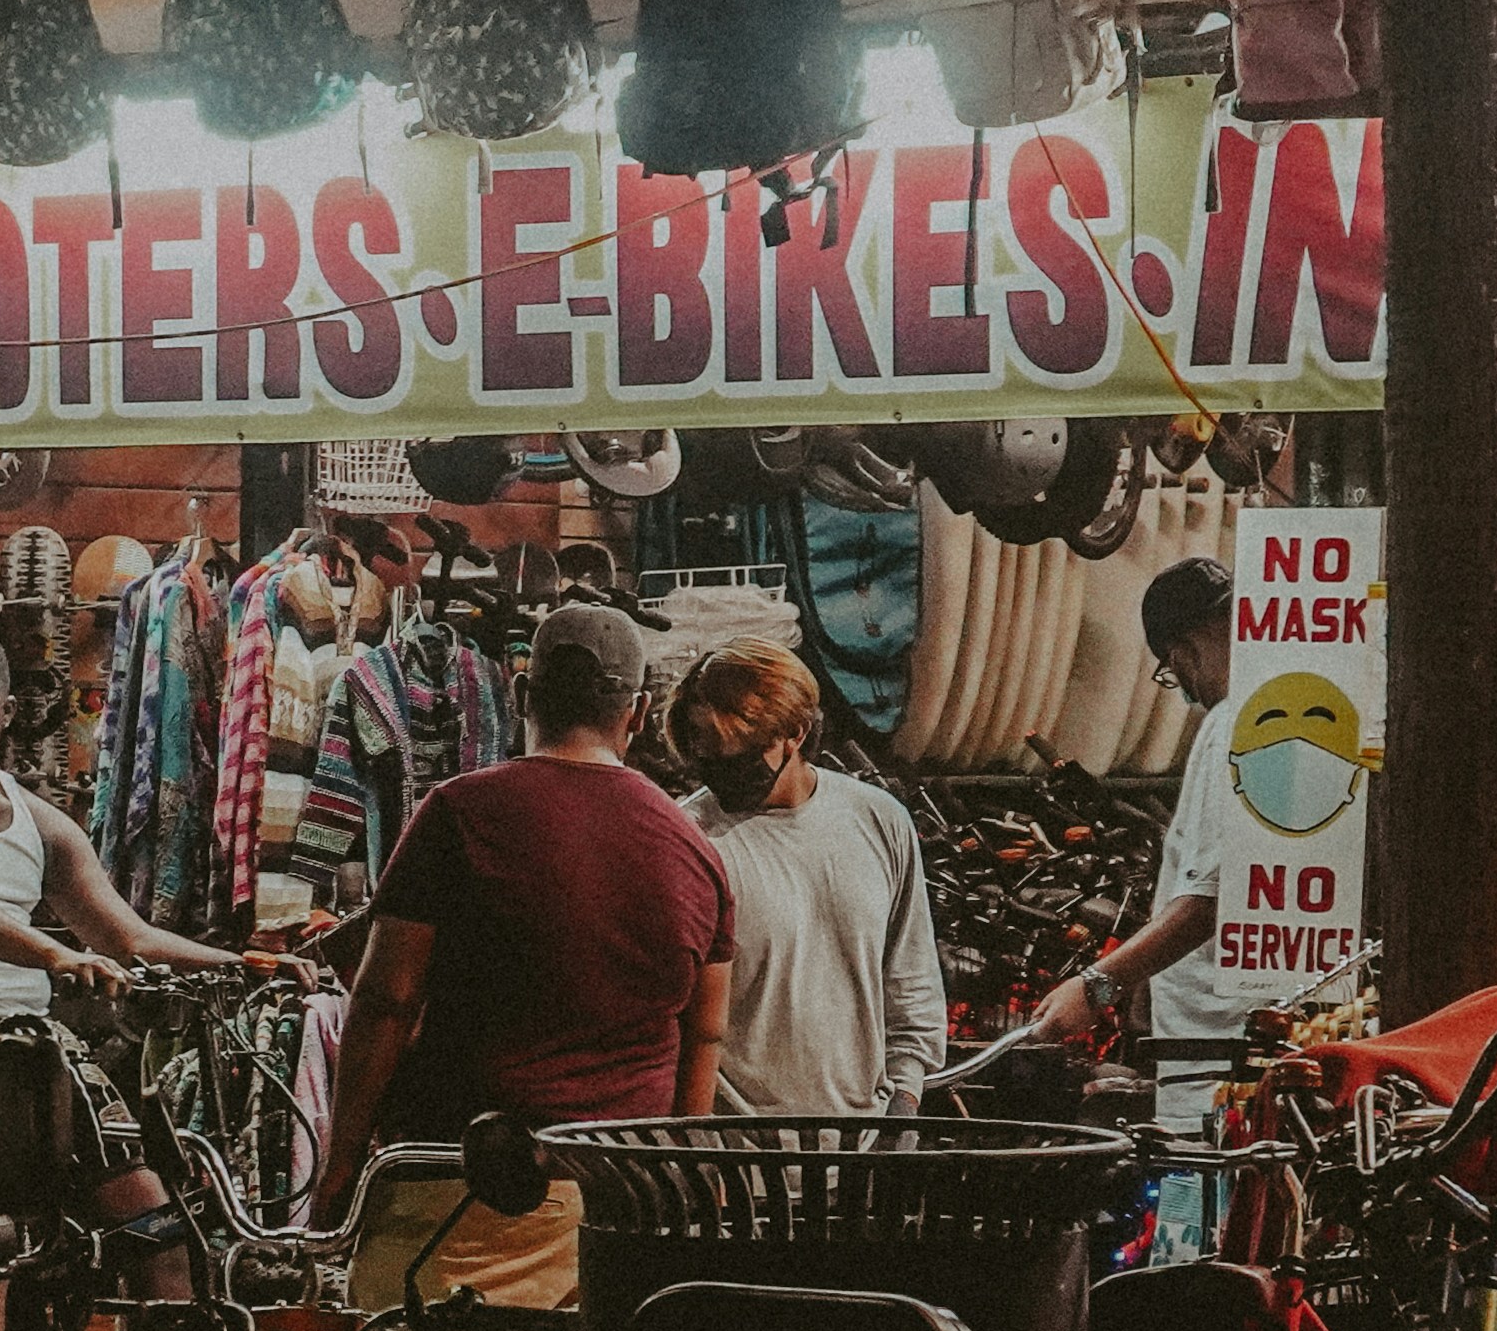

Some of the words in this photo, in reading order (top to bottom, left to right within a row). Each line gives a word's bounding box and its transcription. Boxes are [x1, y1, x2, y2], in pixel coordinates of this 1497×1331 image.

[480, 136, 1110, 392] E-BIKES
[1263, 537, 1352, 584] NO
[1237, 596, 1368, 644] MASK
[1247, 864, 1336, 913] NO
[1221, 923, 1355, 973] SERVICE
